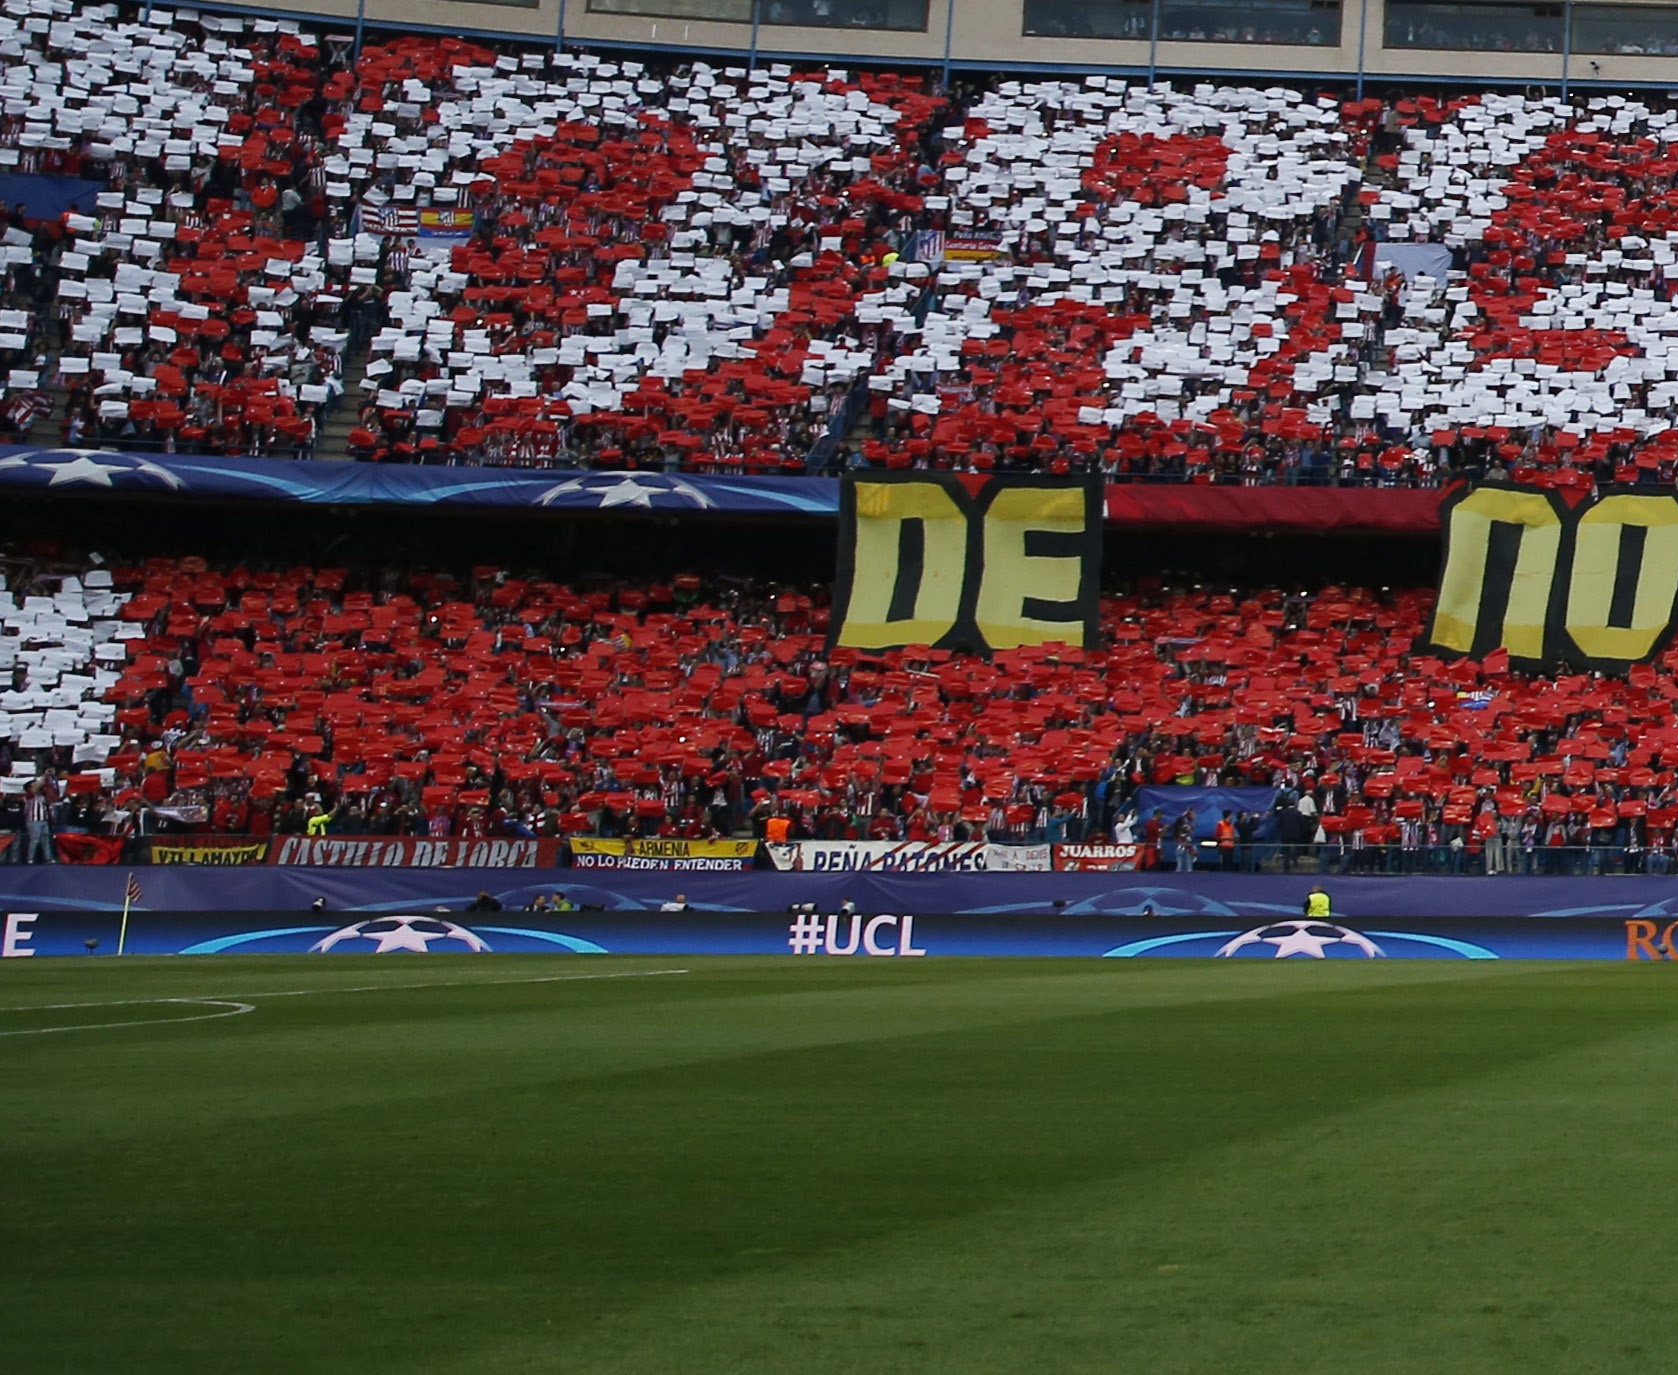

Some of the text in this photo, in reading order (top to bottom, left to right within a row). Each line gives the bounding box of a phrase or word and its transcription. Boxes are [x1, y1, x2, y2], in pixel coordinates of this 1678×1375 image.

[837, 481, 1086, 650] DE
[278, 837, 405, 866] CASTILLO
[639, 841, 690, 856] ARMENIA
[814, 844, 872, 872] PEÑA
[1059, 845, 1137, 859] JUARROS
[577, 855, 595, 867] NO
[598, 855, 615, 868] LO
[674, 858, 743, 871] ENTENDER
[788, 914, 927, 957] #UCL
